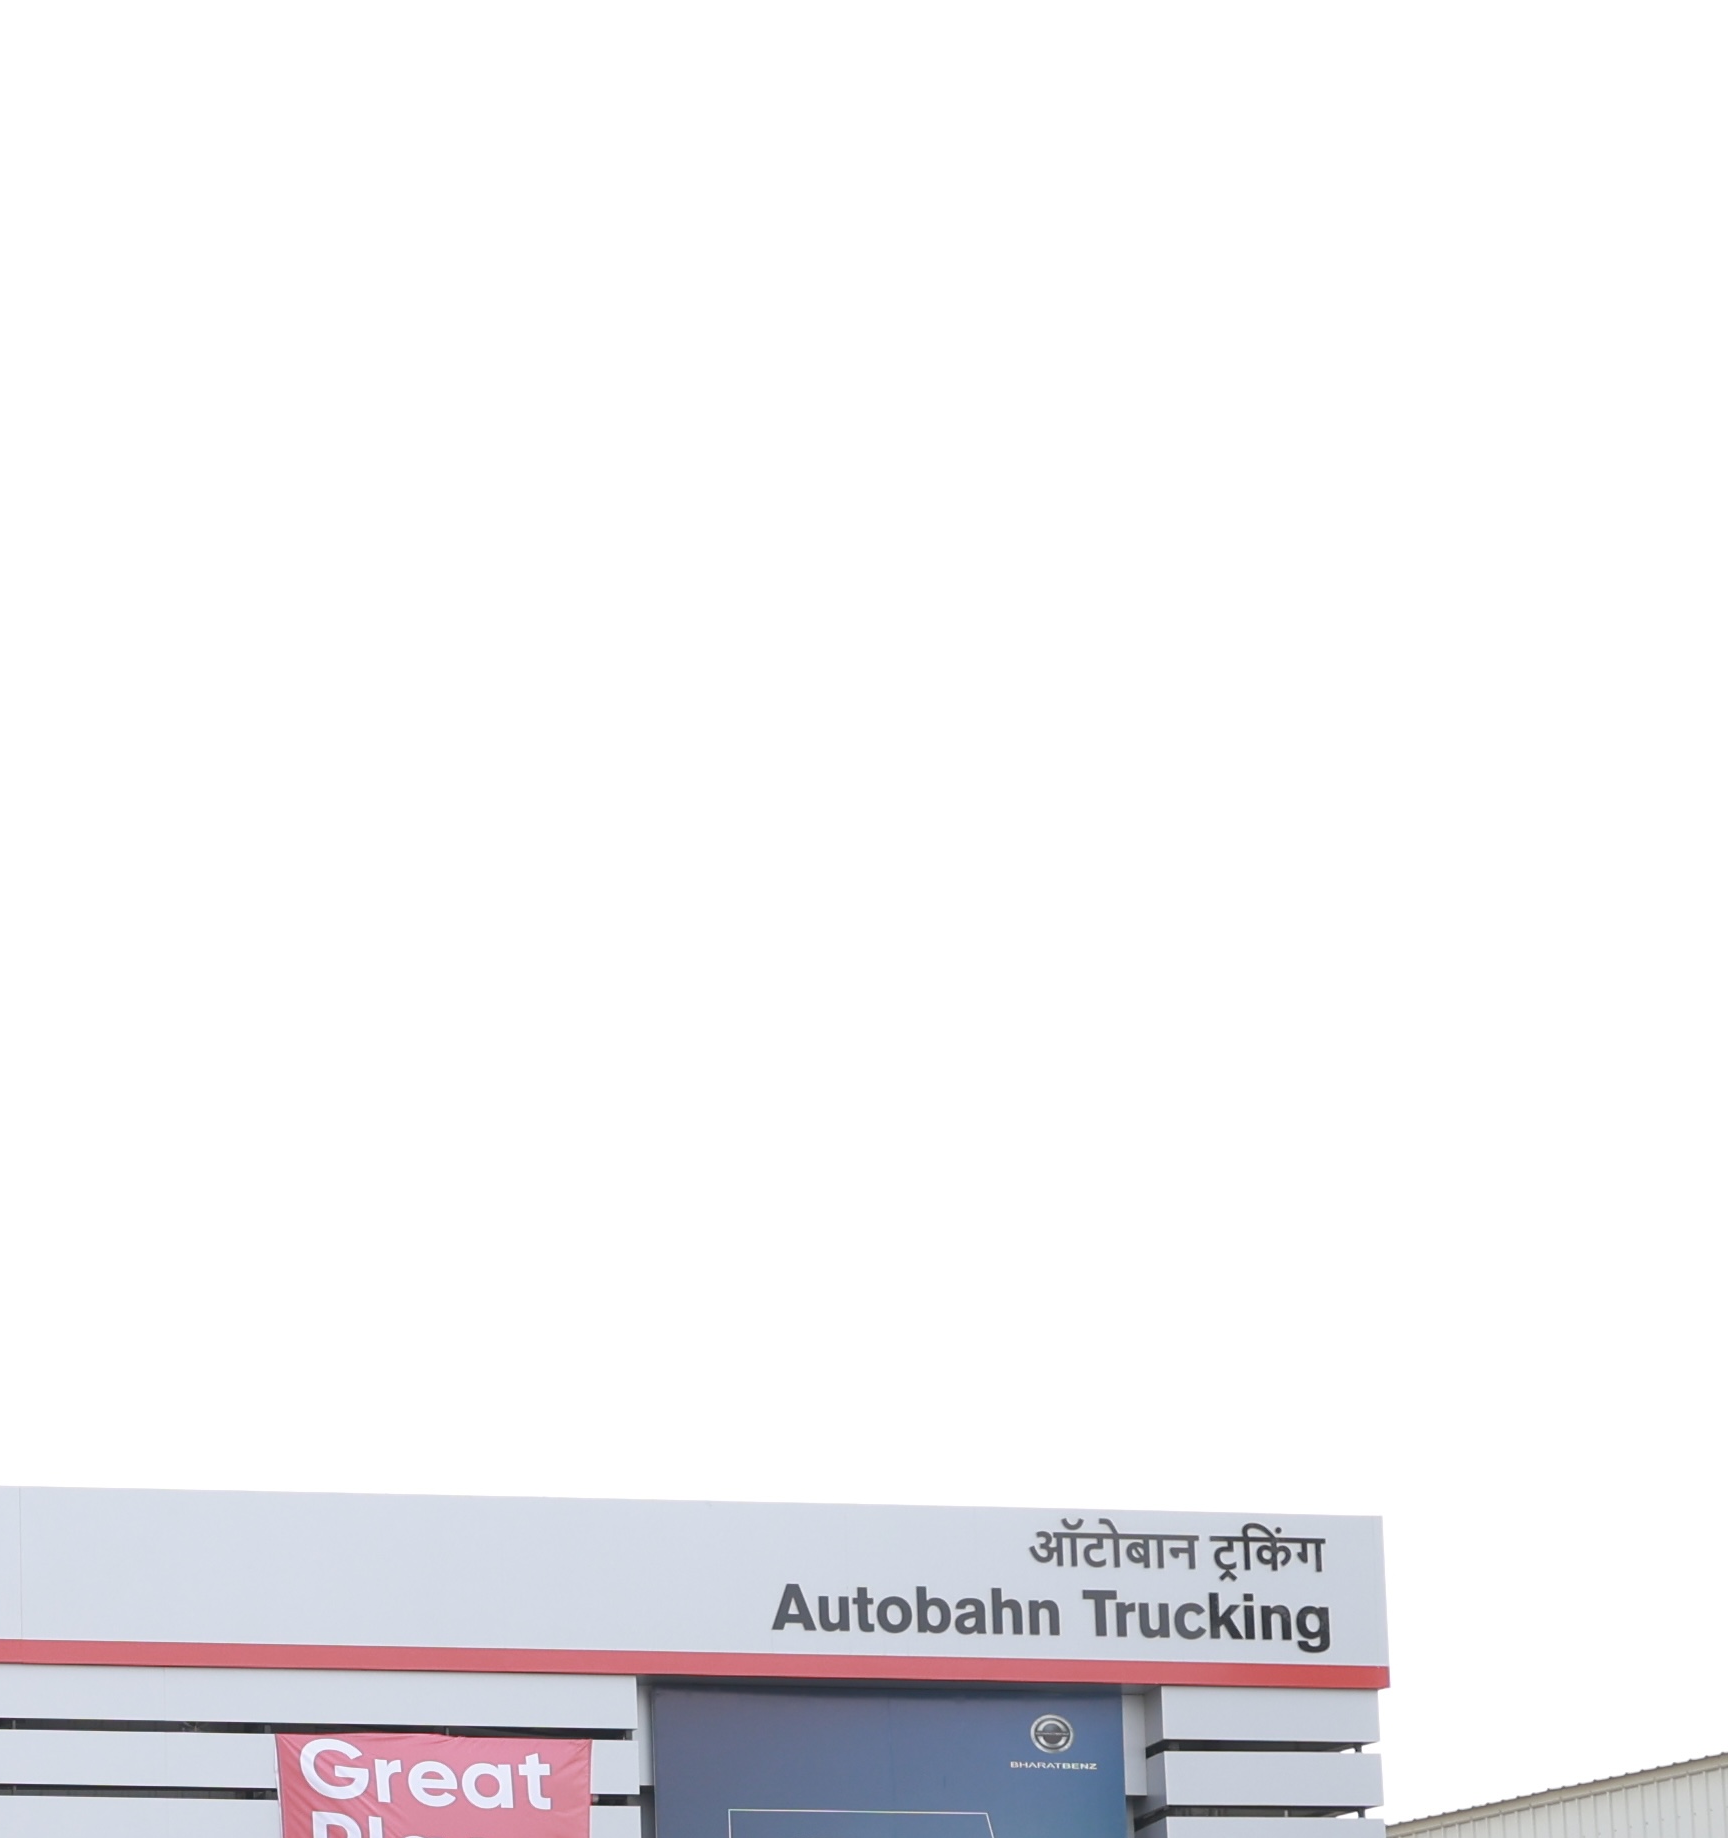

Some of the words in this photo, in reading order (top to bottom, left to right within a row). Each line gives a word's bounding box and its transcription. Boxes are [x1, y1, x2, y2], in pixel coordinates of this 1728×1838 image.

[1029, 1518, 1200, 1571] ऑटोबान
[1209, 1522, 1327, 1581] ट्रकिंग
[771, 1583, 1062, 1636] Autobahn
[1082, 1589, 1332, 1653] Trucking
[299, 1737, 552, 1811] Great
[1010, 1761, 1098, 1770] BHARATBENZ
